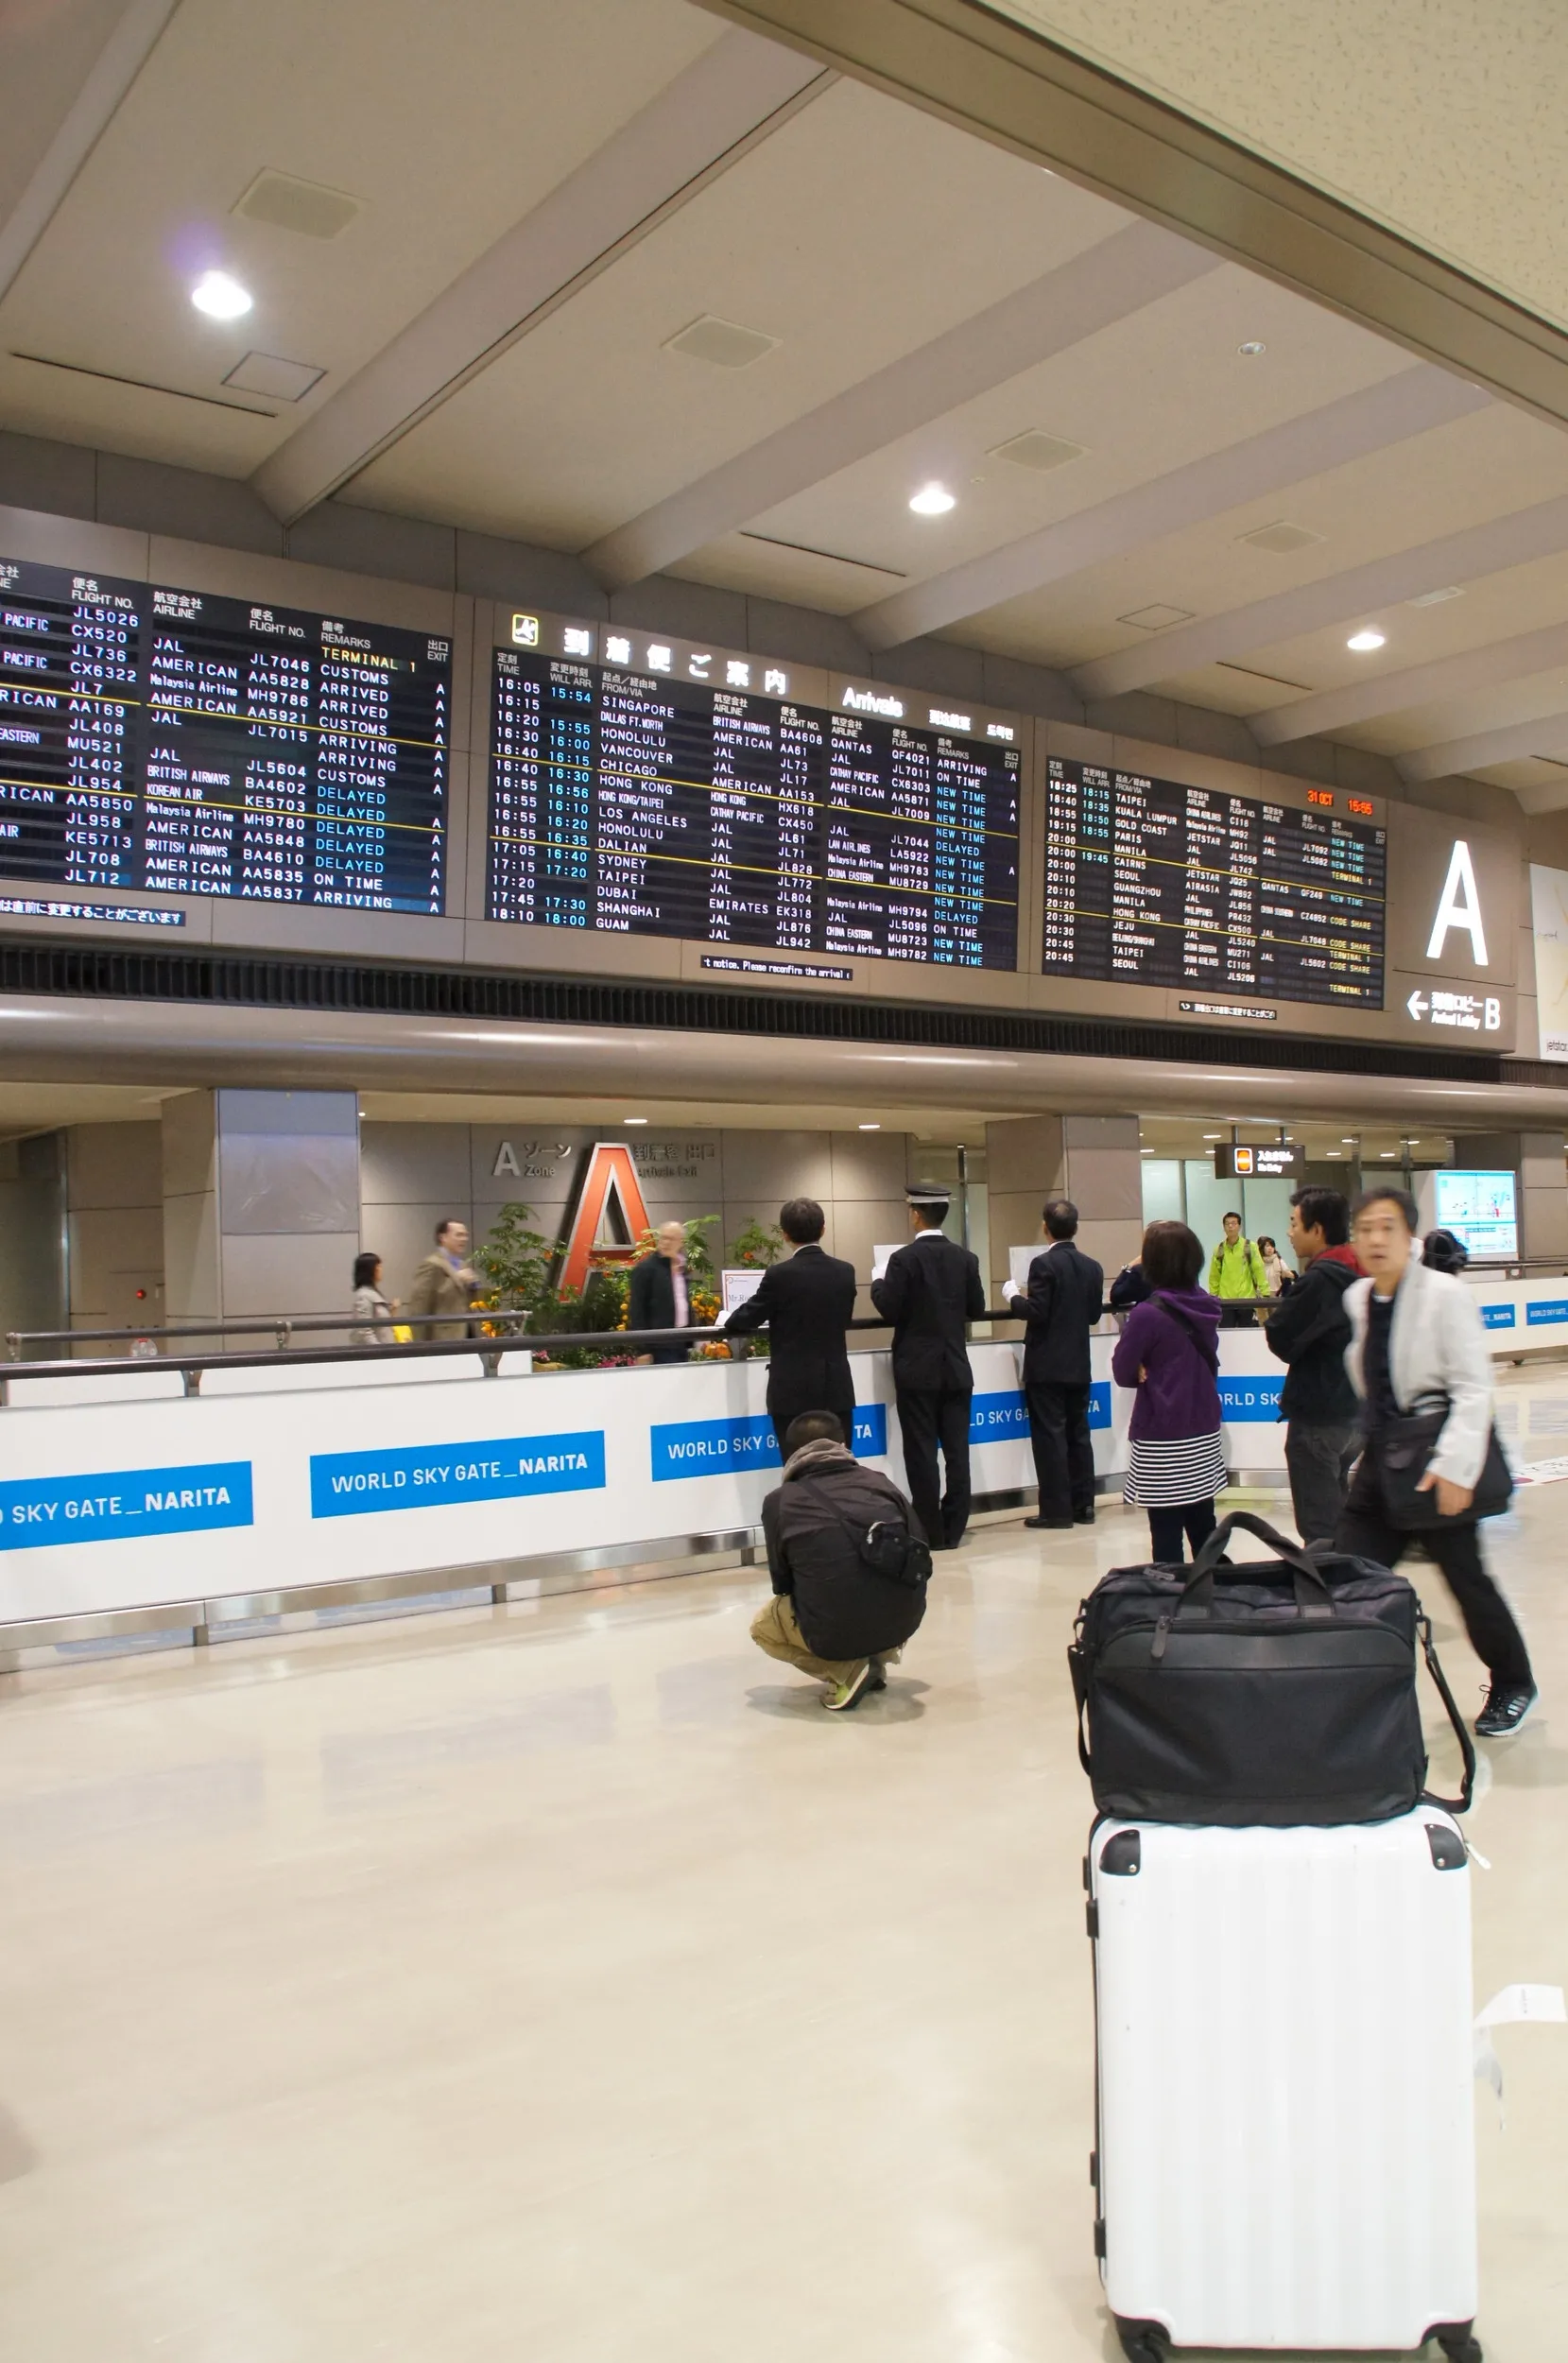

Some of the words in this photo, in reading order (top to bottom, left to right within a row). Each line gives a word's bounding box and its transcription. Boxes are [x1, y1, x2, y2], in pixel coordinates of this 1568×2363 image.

[73, 577, 98, 592] 便名
[72, 590, 112, 605] FLIGHT
[114, 597, 134, 609] NO.
[153, 592, 202, 610] 航空会社
[5, 612, 49, 631] PACIFIC
[74, 607, 139, 628] JL5026
[153, 606, 196, 620] AIRLINE
[72, 625, 127, 644] CX520
[250, 620, 284, 634] FLIGHT
[288, 627, 306, 638] NO.
[154, 638, 184, 653] JAL
[320, 632, 371, 649] REMARKS
[427, 640, 448, 652] 出口
[72, 644, 127, 663] JL736
[322, 647, 398, 670] TERMINAL
[411, 663, 415, 673] 1
[427, 651, 448, 663] EXIT
[152, 656, 237, 680] AMERICAN
[250, 654, 310, 673] JL7046
[497, 664, 520, 676] TIME
[250, 671, 310, 690] AA5828
[321, 664, 389, 685] CUSTOMS
[550, 673, 571, 685] WILL
[150, 674, 195, 691] Malaysia
[199, 681, 238, 697] Airline
[320, 682, 389, 702] ARRIVED
[437, 684, 445, 695] A
[499, 678, 541, 695] 16:05
[602, 683, 644, 699] FROM/VIA
[249, 688, 309, 708] MH9786
[499, 694, 540, 711] 16:15
[552, 687, 592, 703] 15:54
[842, 687, 904, 717] Arrivals
[69, 699, 125, 718] AA169
[603, 696, 675, 718] SINGAPORE
[714, 704, 743, 716] AIRLINE
[436, 717, 444, 729] A
[780, 716, 806, 729] FLIGHT
[498, 727, 539, 743] 16:30
[551, 735, 591, 750] 16:00
[602, 728, 666, 748] HONOLULU
[714, 732, 773, 750] AMERICAN
[781, 729, 823, 745] BA4608
[68, 737, 121, 754] MU521
[601, 743, 673, 765] VANCOUVER
[714, 748, 735, 760] JAL
[781, 744, 807, 757] AA61
[832, 738, 872, 754] QANTAS
[937, 746, 970, 760] REMARKS
[147, 765, 188, 781] BRITISH
[192, 770, 231, 786] AIRWAYS
[248, 760, 307, 778] JL5604
[893, 765, 929, 779] JL7011
[938, 759, 988, 776] ARRIVING
[318, 768, 386, 788] CUSTOMS
[600, 775, 632, 789] HONG
[642, 782, 673, 795] KONG
[1010, 773, 1017, 782] A
[318, 786, 386, 805] DELAYED
[549, 784, 589, 799] 16:56
[831, 782, 885, 800] AMERICAN
[937, 801, 956, 811] NEW
[962, 804, 986, 817] TIME
[67, 813, 121, 829] JL958
[779, 818, 814, 831] CX450
[244, 832, 305, 848] AA5848
[937, 841, 980, 856] DELAYED
[494, 858, 536, 873] 17:15
[598, 854, 646, 870] SYDNEY
[890, 863, 929, 877] MH9783
[65, 870, 120, 886] JL712
[315, 873, 335, 887] ON
[345, 876, 383, 891] TIME
[597, 902, 660, 919] SHANGHAI
[710, 899, 768, 914] EMIRATES
[1426, 839, 1489, 966] A
[545, 913, 586, 926] 18:00
[777, 906, 812, 920] EK318
[742, 960, 767, 972] Please
[768, 964, 802, 975] reconfirm
[805, 967, 817, 976] the
[818, 969, 843, 979] arrival
[1485, 997, 1501, 1030] B
[492, 1141, 520, 1177] A
[526, 1164, 557, 1178] Zone
[559, 1142, 657, 1303] A
[1217, 1392, 1255, 1406] ORLD
[1260, 1392, 1281, 1406] SK
[989, 1410, 1012, 1423] SKY
[667, 1439, 728, 1459] WORLD
[732, 1435, 764, 1453] SKY
[331, 1470, 406, 1493] WORLD
[412, 1466, 451, 1486] SKY
[12, 1502, 59, 1525] SKY
